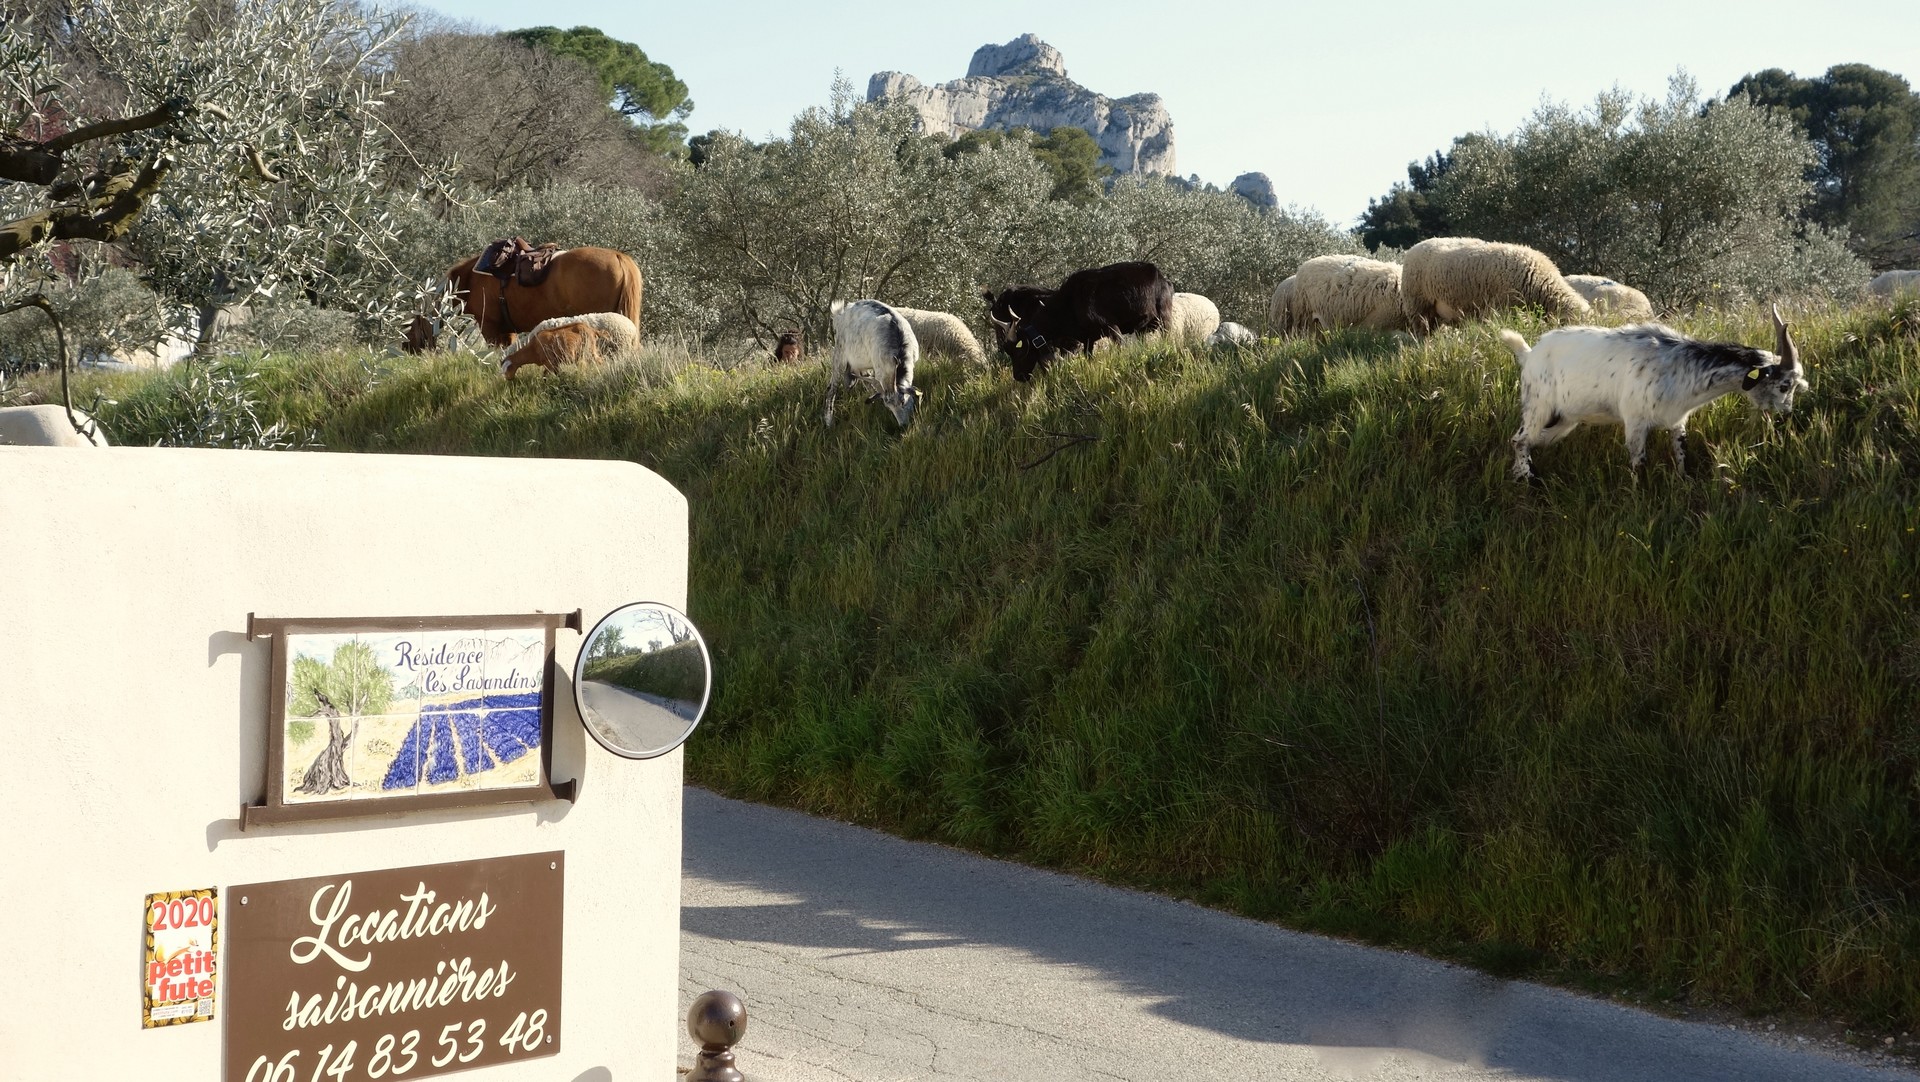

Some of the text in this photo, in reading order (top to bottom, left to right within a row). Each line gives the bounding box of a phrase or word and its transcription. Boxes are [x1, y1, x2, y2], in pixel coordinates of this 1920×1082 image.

[395, 641, 483, 671] Résidence
[453, 665, 536, 690] Lavandins
[152, 897, 213, 931] 2020
[290, 880, 496, 972] Locations
[149, 950, 214, 985] petit
[159, 977, 213, 1002] fute
[282, 957, 516, 1031] saisonnières
[245, 1009, 547, 1082] 06 14 83 53 48
